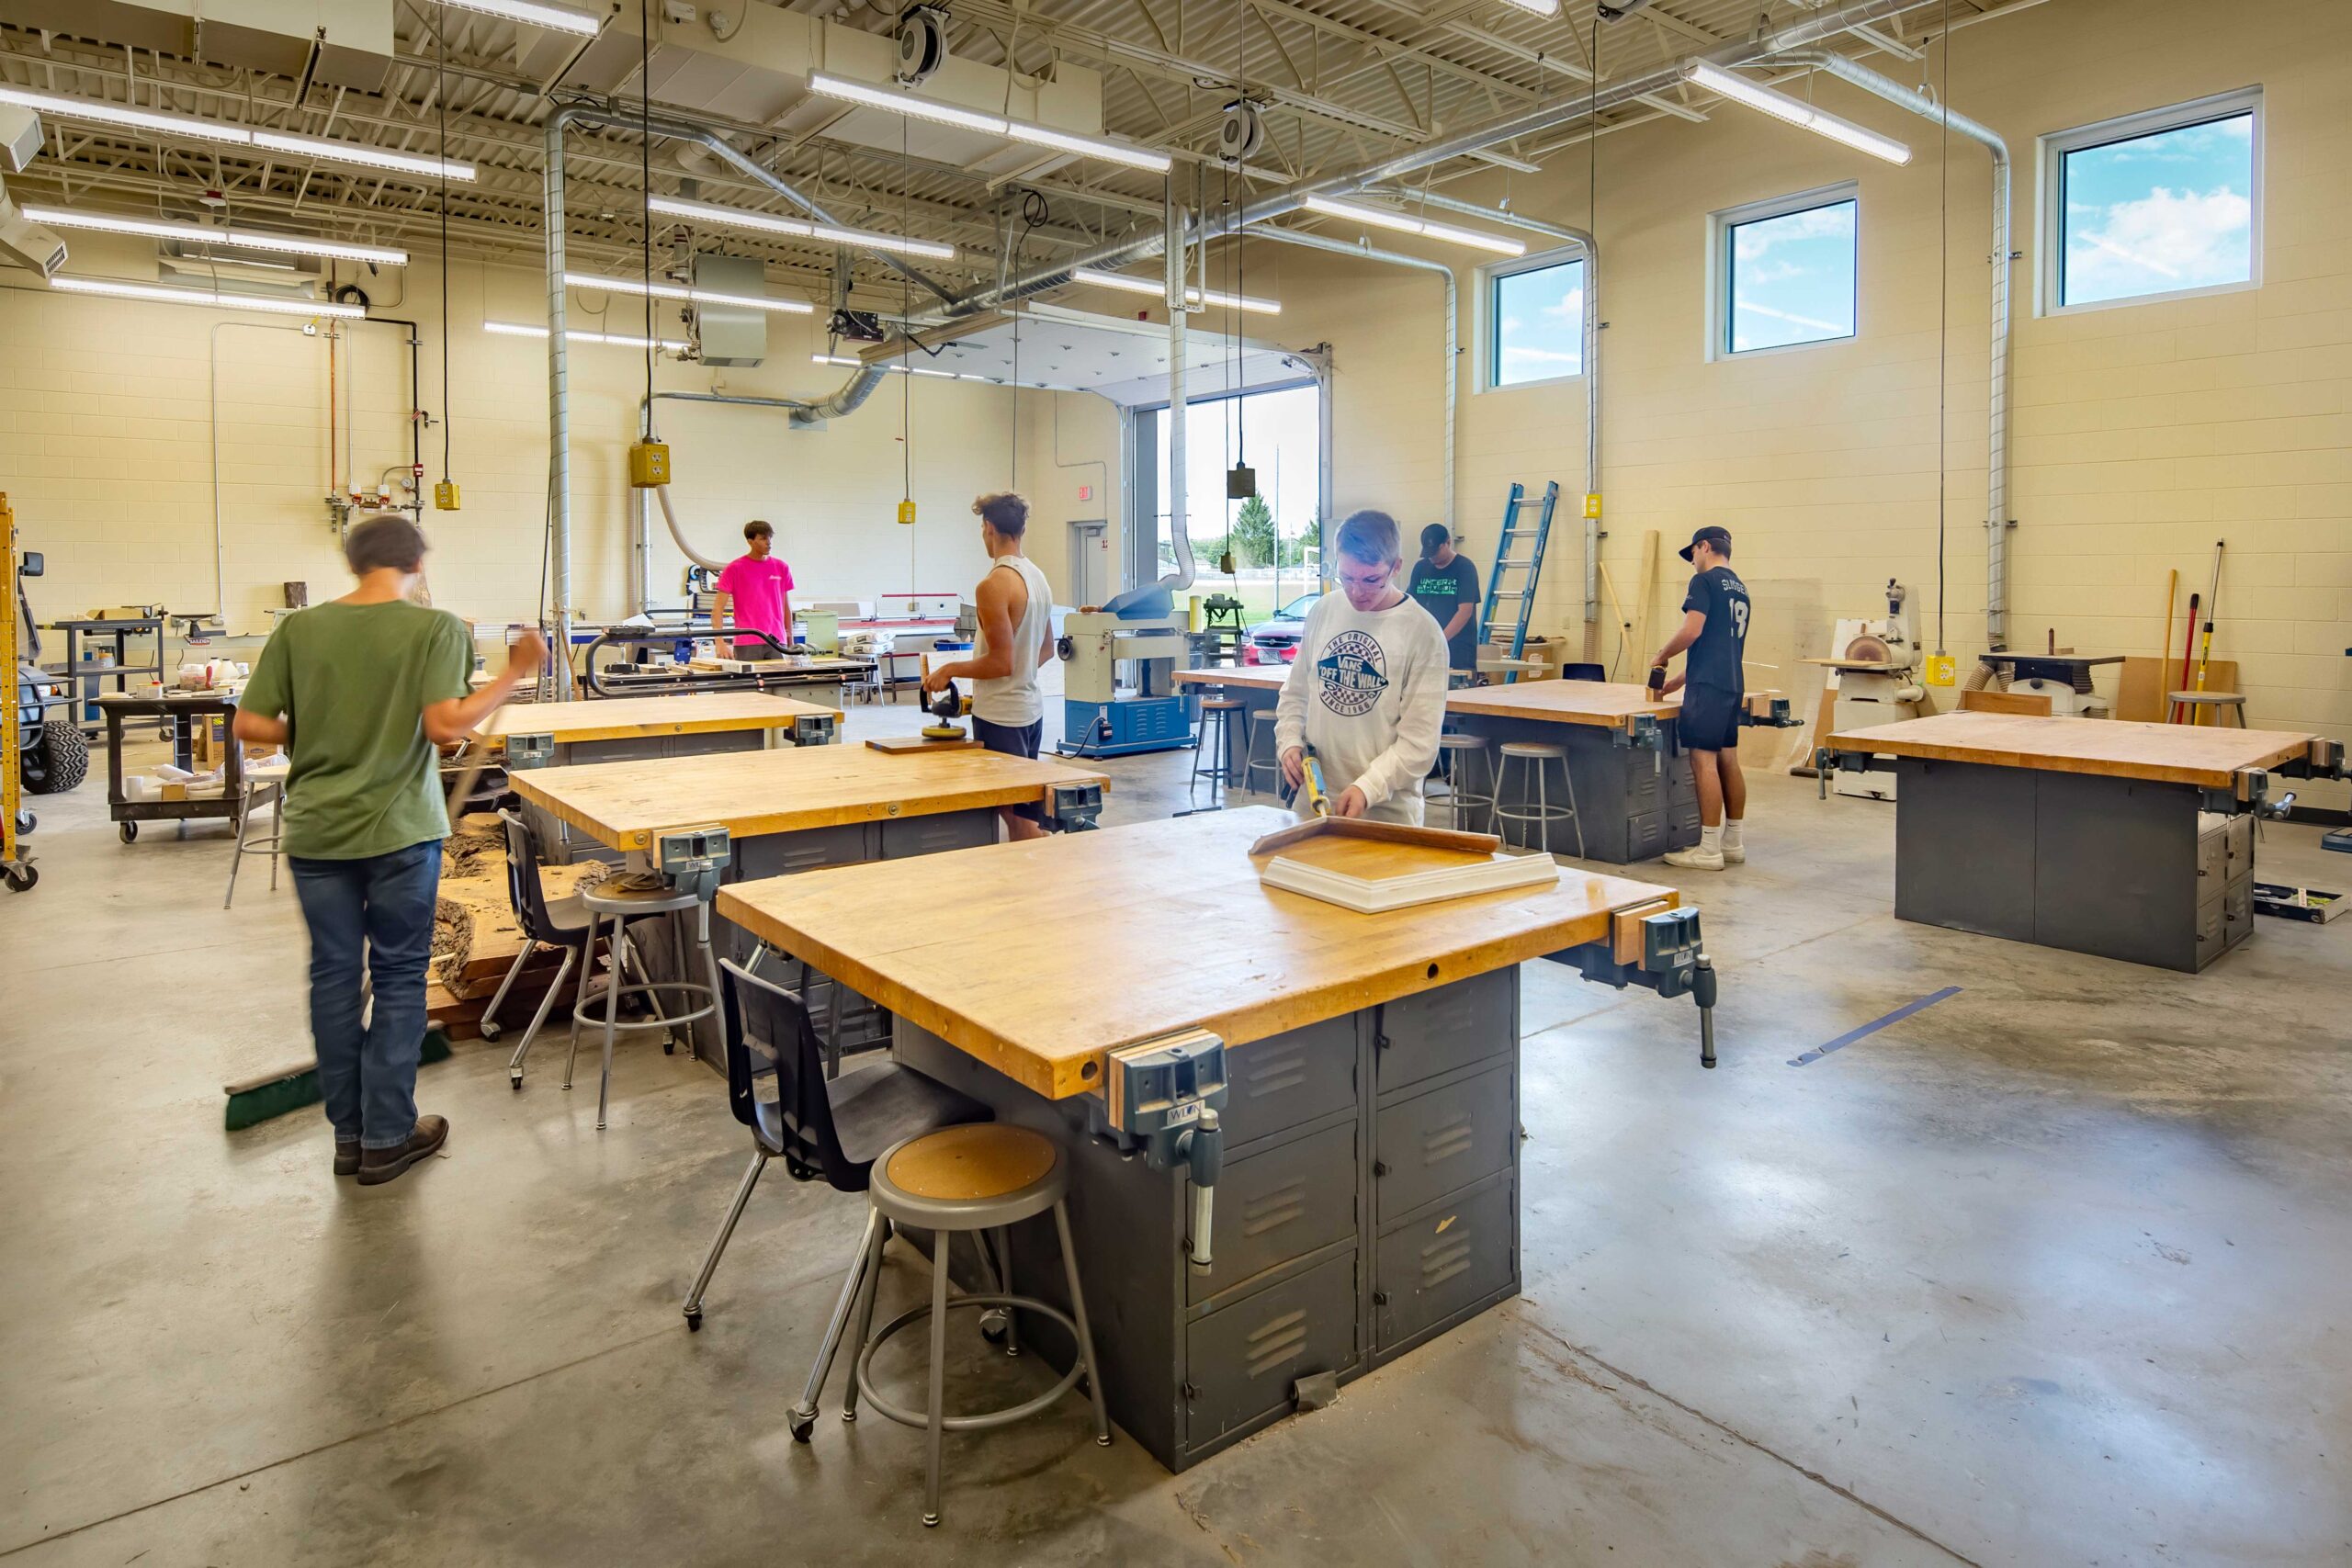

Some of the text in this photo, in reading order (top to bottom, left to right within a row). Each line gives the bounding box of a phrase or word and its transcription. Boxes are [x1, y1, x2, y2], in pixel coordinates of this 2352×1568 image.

[1328, 633, 1383, 663] THE ORIGINAL
[1337, 655, 1364, 672] VANS
[1340, 669, 1356, 688] THE
[1320, 690, 1371, 714] SINCE 1966
